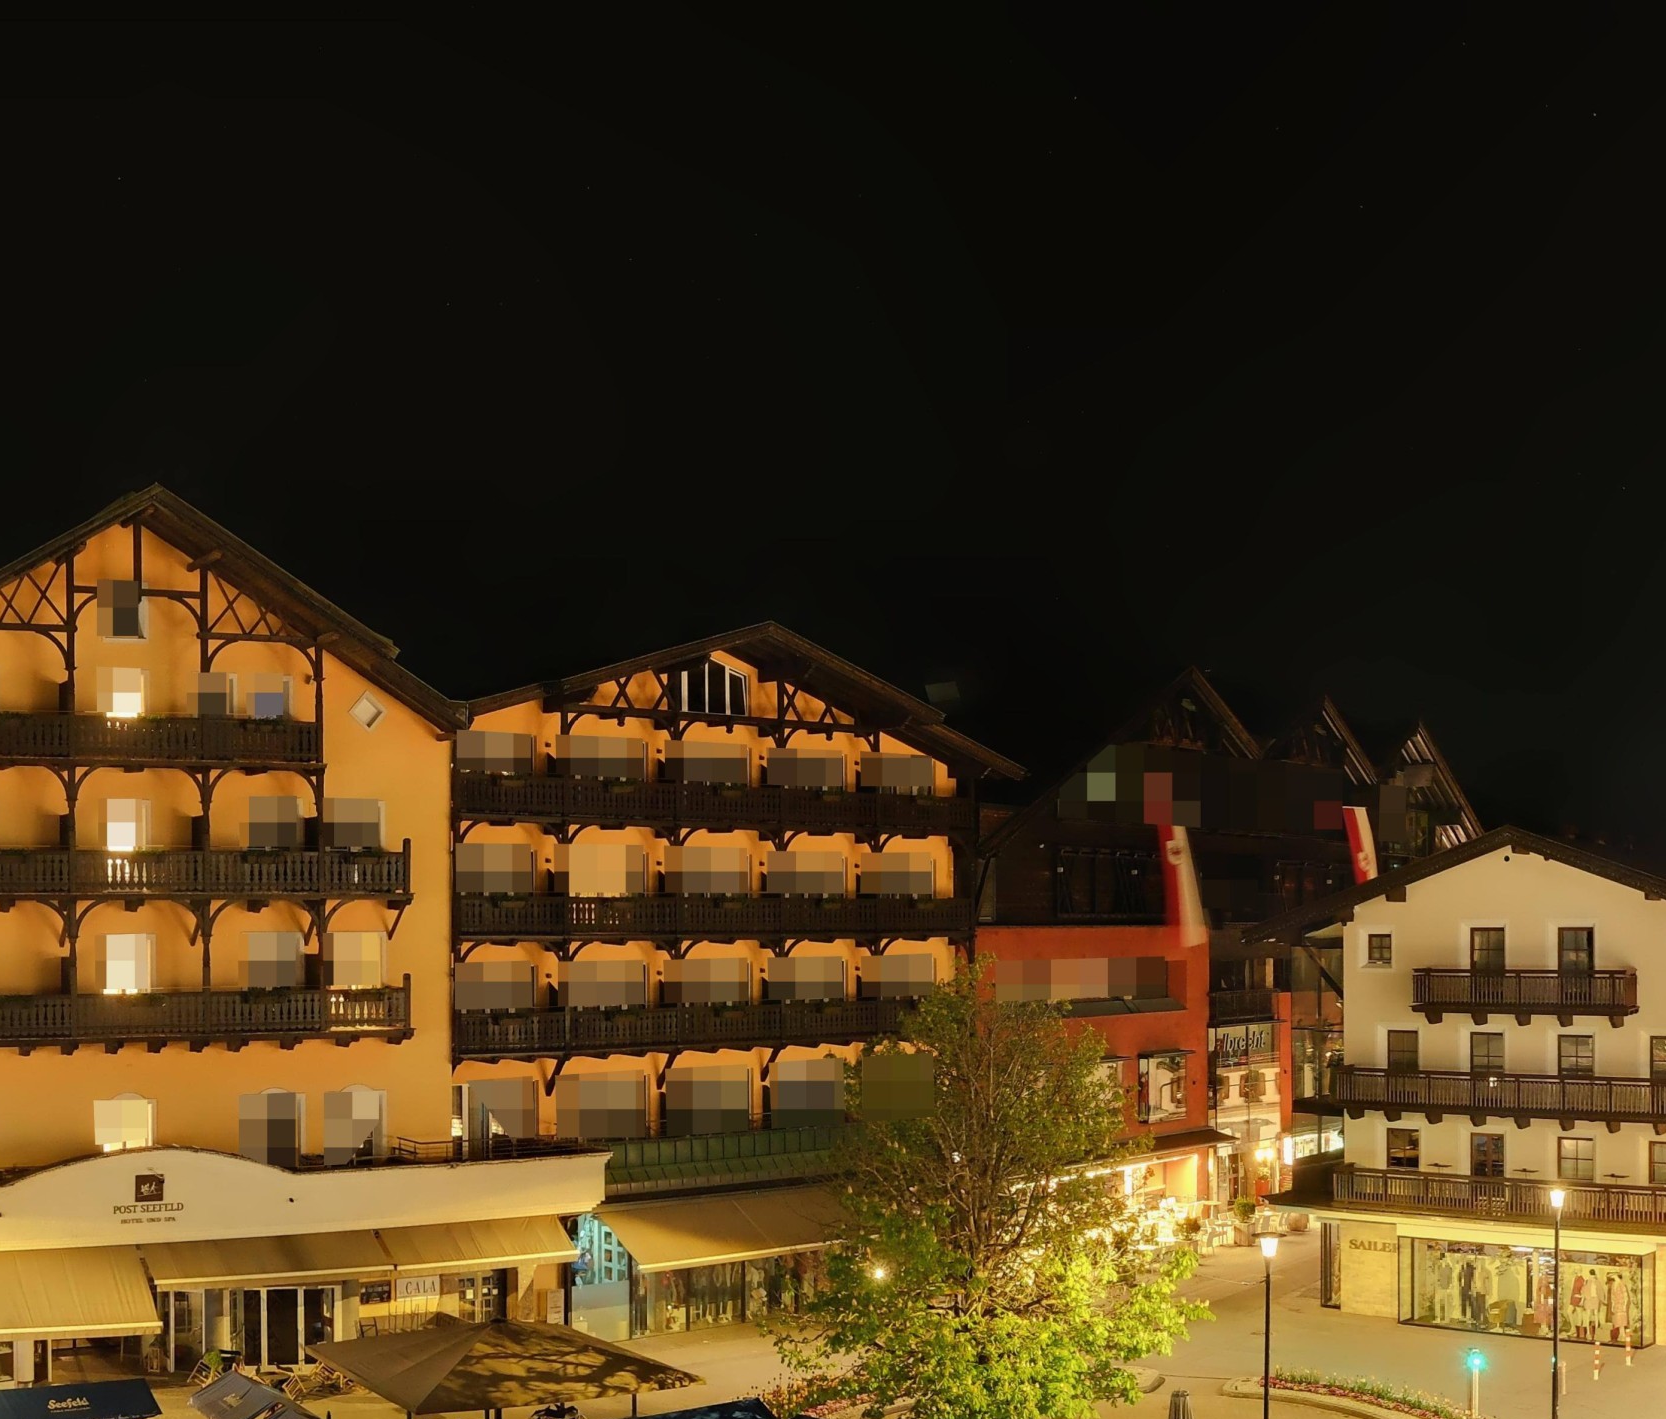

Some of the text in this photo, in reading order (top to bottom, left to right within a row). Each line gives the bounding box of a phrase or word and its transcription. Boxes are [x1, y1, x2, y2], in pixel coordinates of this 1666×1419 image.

[113, 1202, 185, 1215] POST SEEFELD
[121, 1217, 144, 1225] HOTEL
[405, 1279, 436, 1296] CALA
[47, 1396, 90, 1410] Seefeld
